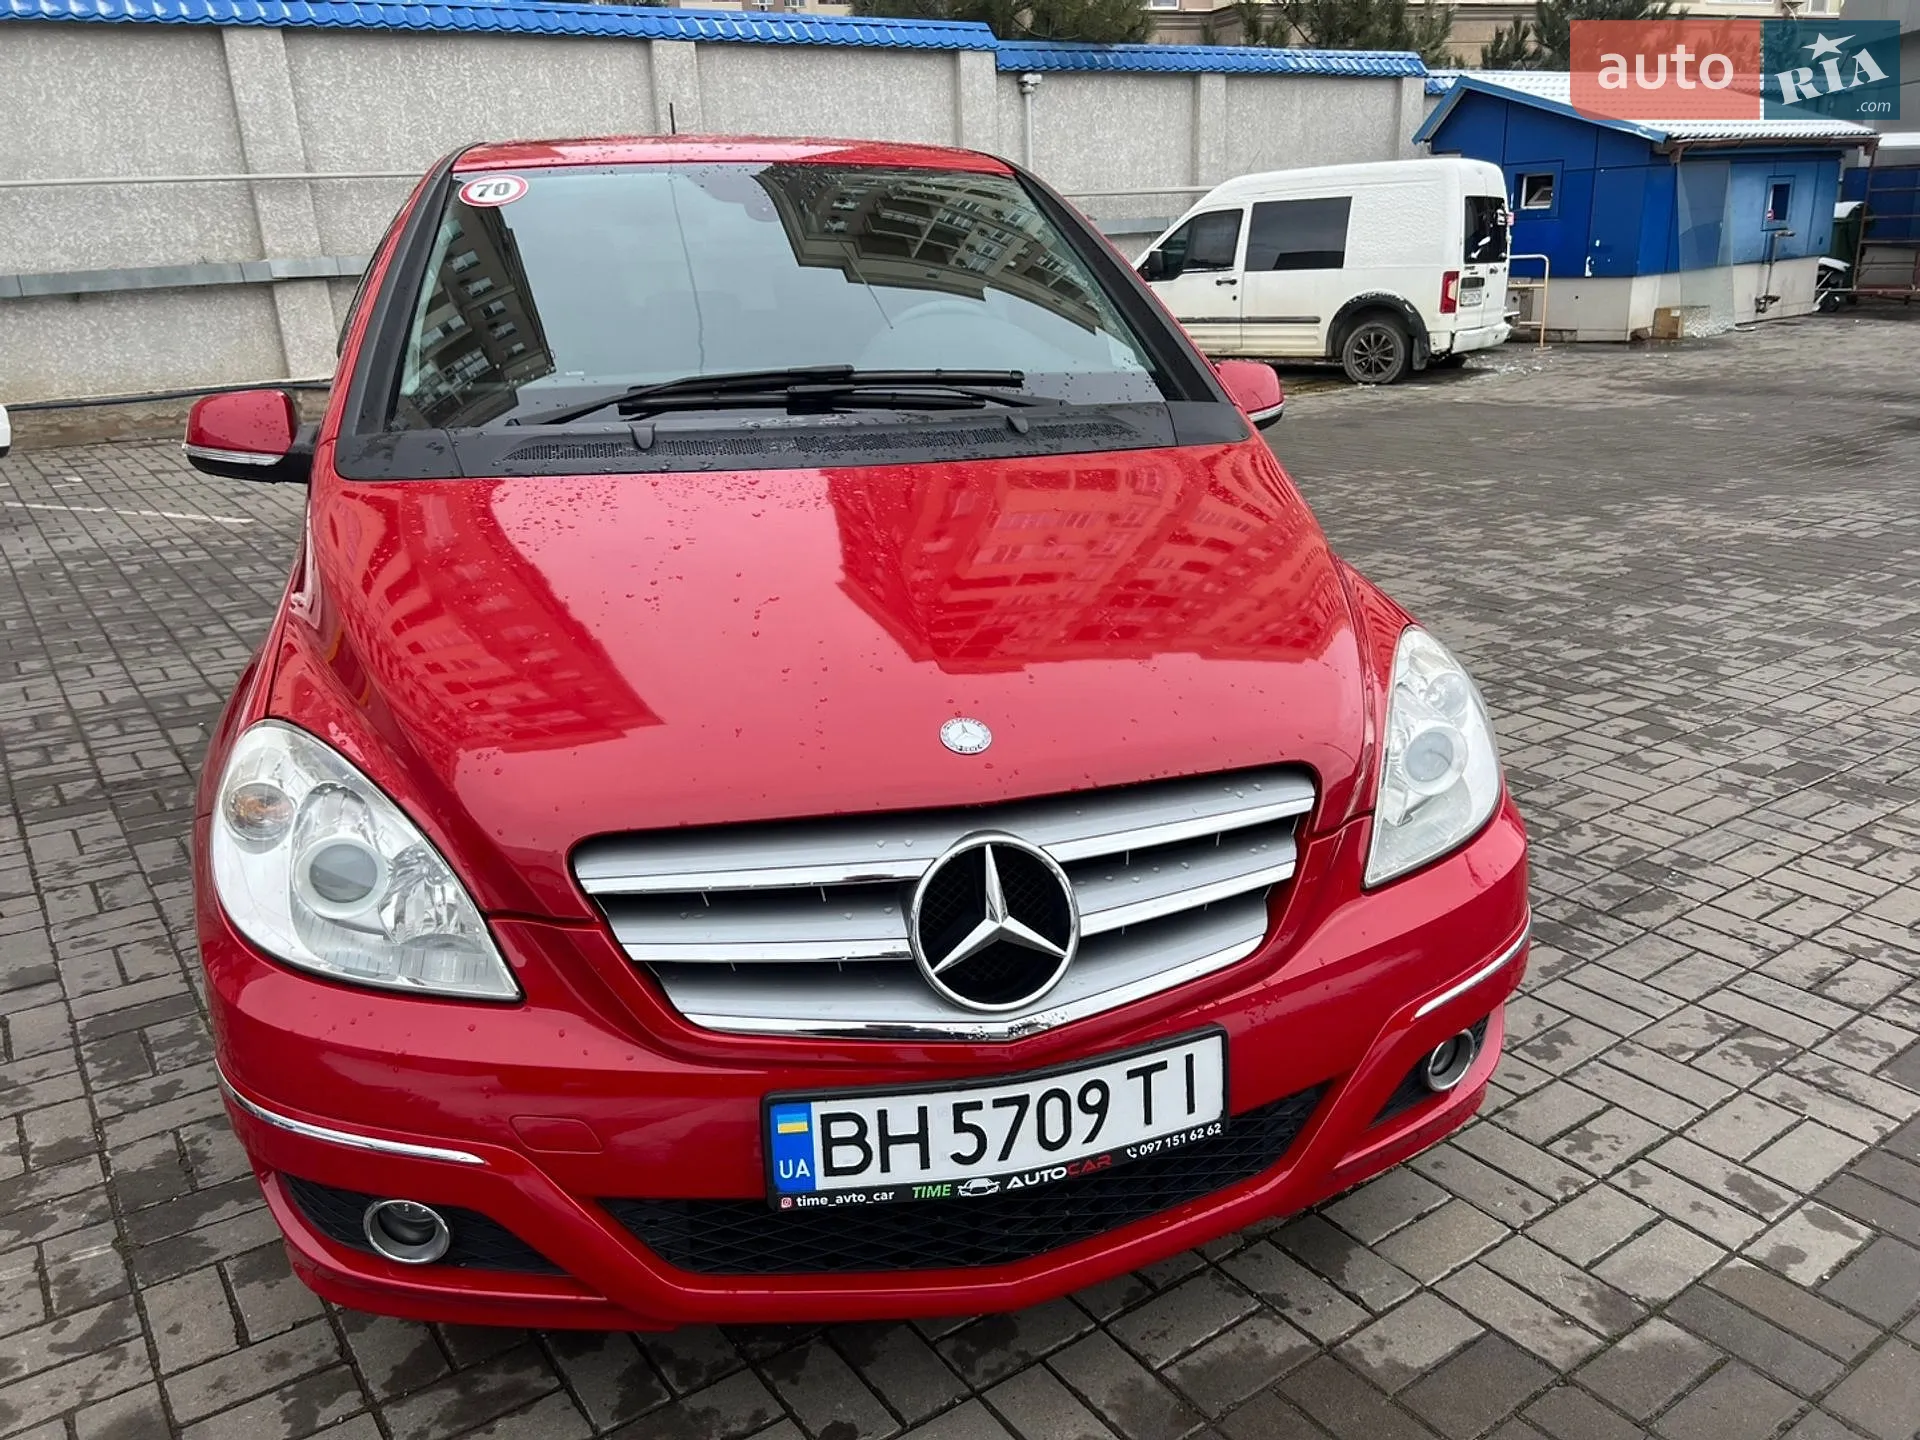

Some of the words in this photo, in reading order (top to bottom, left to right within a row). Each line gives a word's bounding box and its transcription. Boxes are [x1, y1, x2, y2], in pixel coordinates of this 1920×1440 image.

[477, 182, 511, 197] 70
[819, 1105, 931, 1177] BH
[949, 1078, 1110, 1166] 5709
[1126, 1053, 1196, 1126] TI
[1139, 1139, 1163, 1157] 097
[1165, 1133, 1187, 1149] 151
[1189, 1128, 1205, 1144] 62
[1206, 1123, 1222, 1138] 62
[780, 1160, 811, 1180] UA
[912, 1184, 951, 1200] TIME
[1006, 1155, 1113, 1190] AUTOCAR
[796, 1189, 895, 1208] time_avto_car
